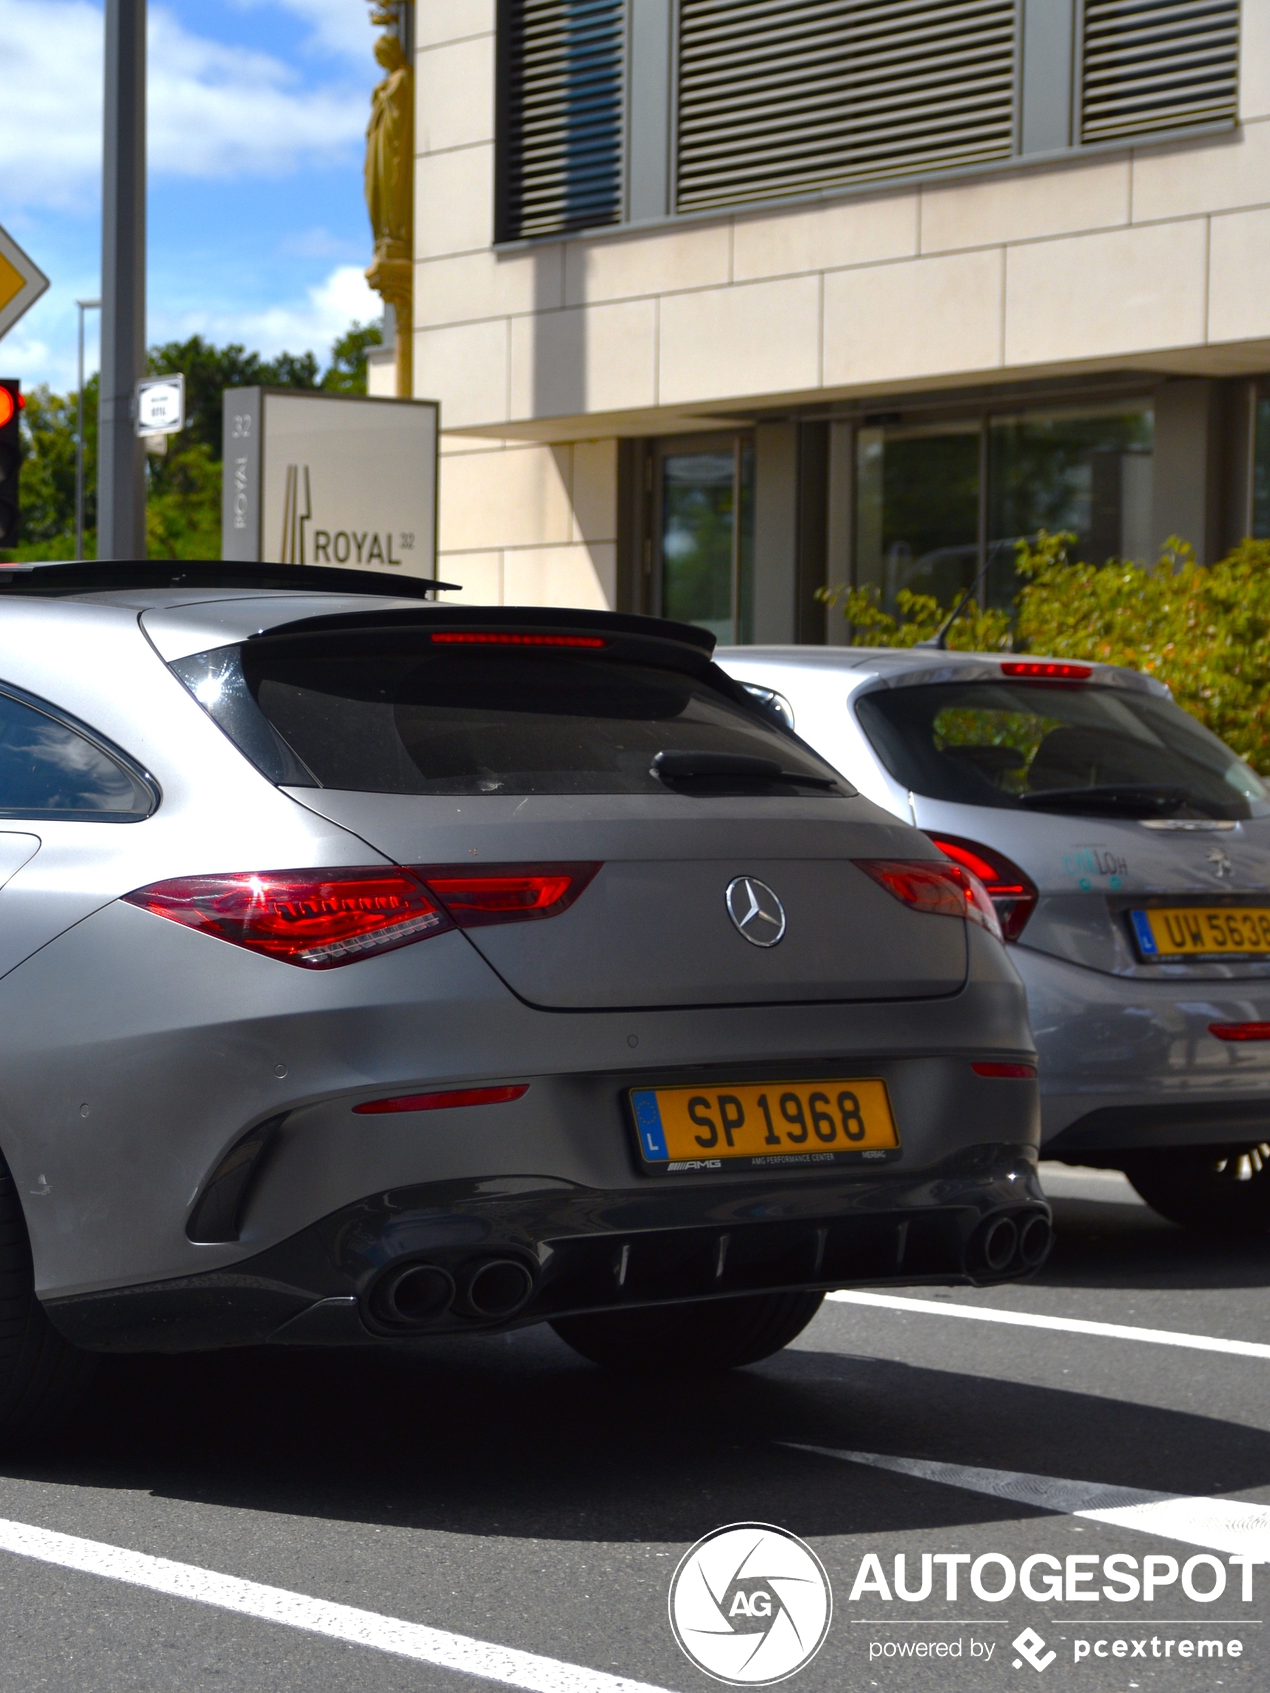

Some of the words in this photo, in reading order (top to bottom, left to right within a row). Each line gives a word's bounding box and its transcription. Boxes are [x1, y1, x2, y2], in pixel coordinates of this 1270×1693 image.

[233, 455, 249, 529] ROYAL
[313, 530, 402, 566] ROYAL
[399, 532, 415, 550] 32
[1164, 914, 1206, 948] UW
[687, 1095, 745, 1149] SP
[757, 1091, 866, 1145] 1968
[646, 1132, 659, 1151] L
[685, 1159, 722, 1170] AMG
[751, 1157, 766, 1166] AMG
[766, 1154, 811, 1164] PERFORMANCE
[812, 1152, 835, 1162] CENTER
